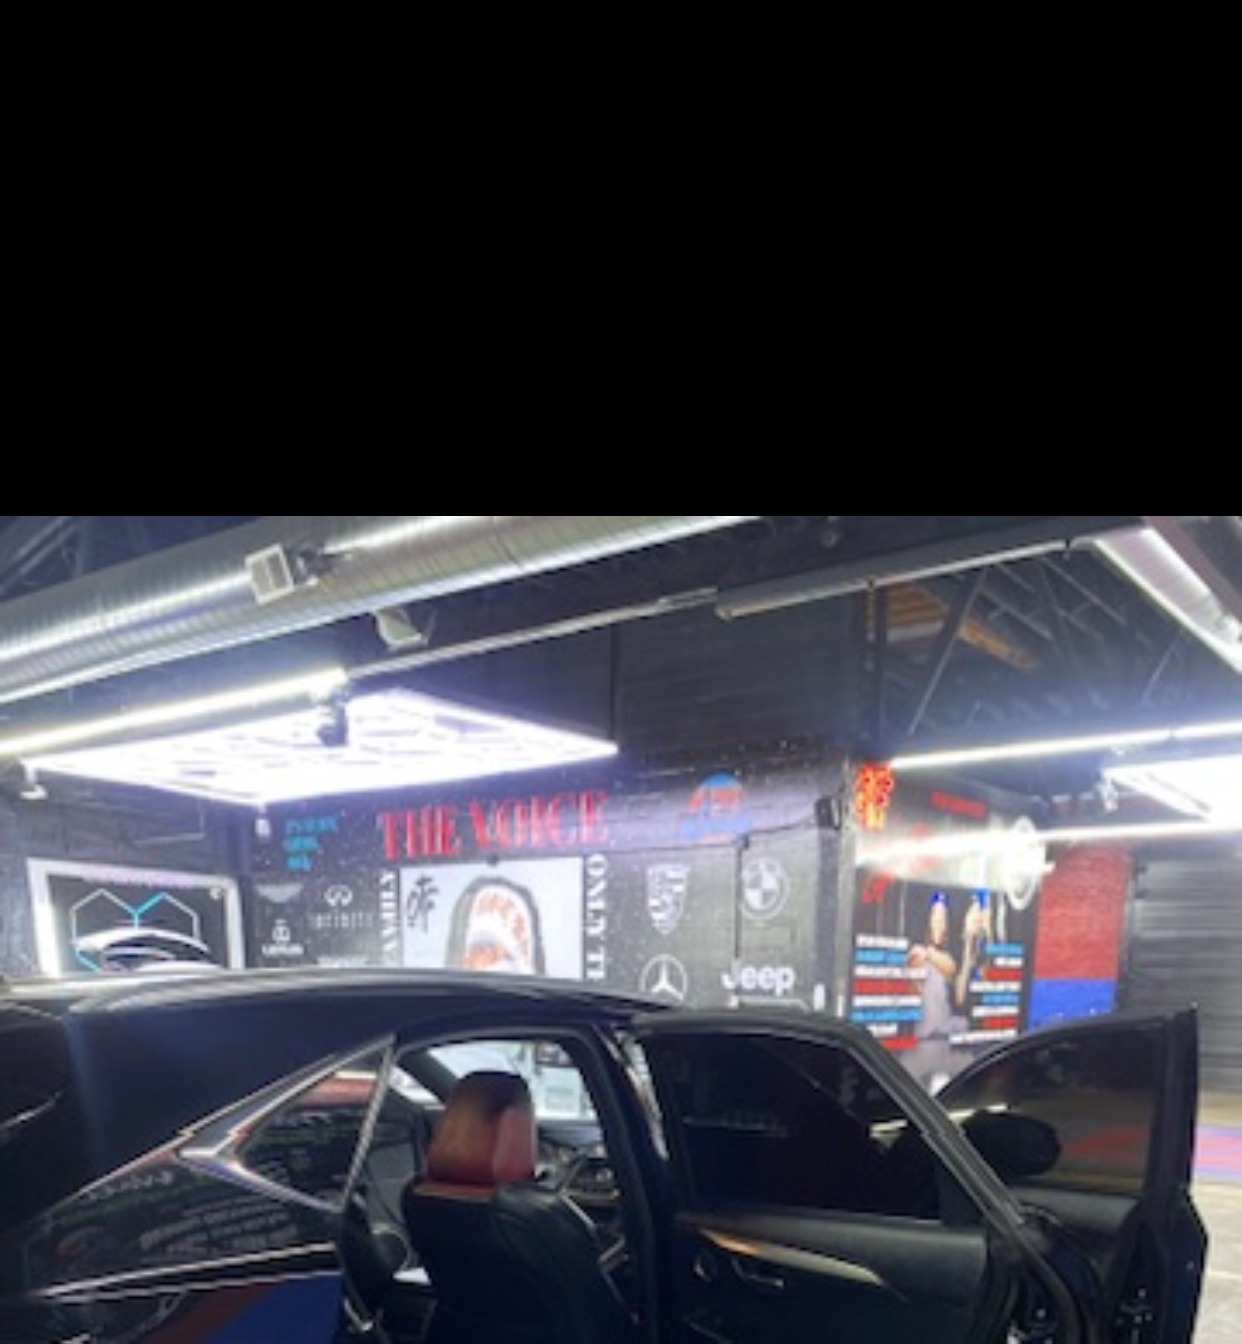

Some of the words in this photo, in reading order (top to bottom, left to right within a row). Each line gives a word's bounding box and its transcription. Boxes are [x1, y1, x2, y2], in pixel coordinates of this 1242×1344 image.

[377, 805, 461, 861] THE
[469, 790, 609, 848] VOICE
[378, 868, 398, 967] AMILY
[586, 853, 607, 940] ONLY
[721, 959, 796, 996] Jeep
